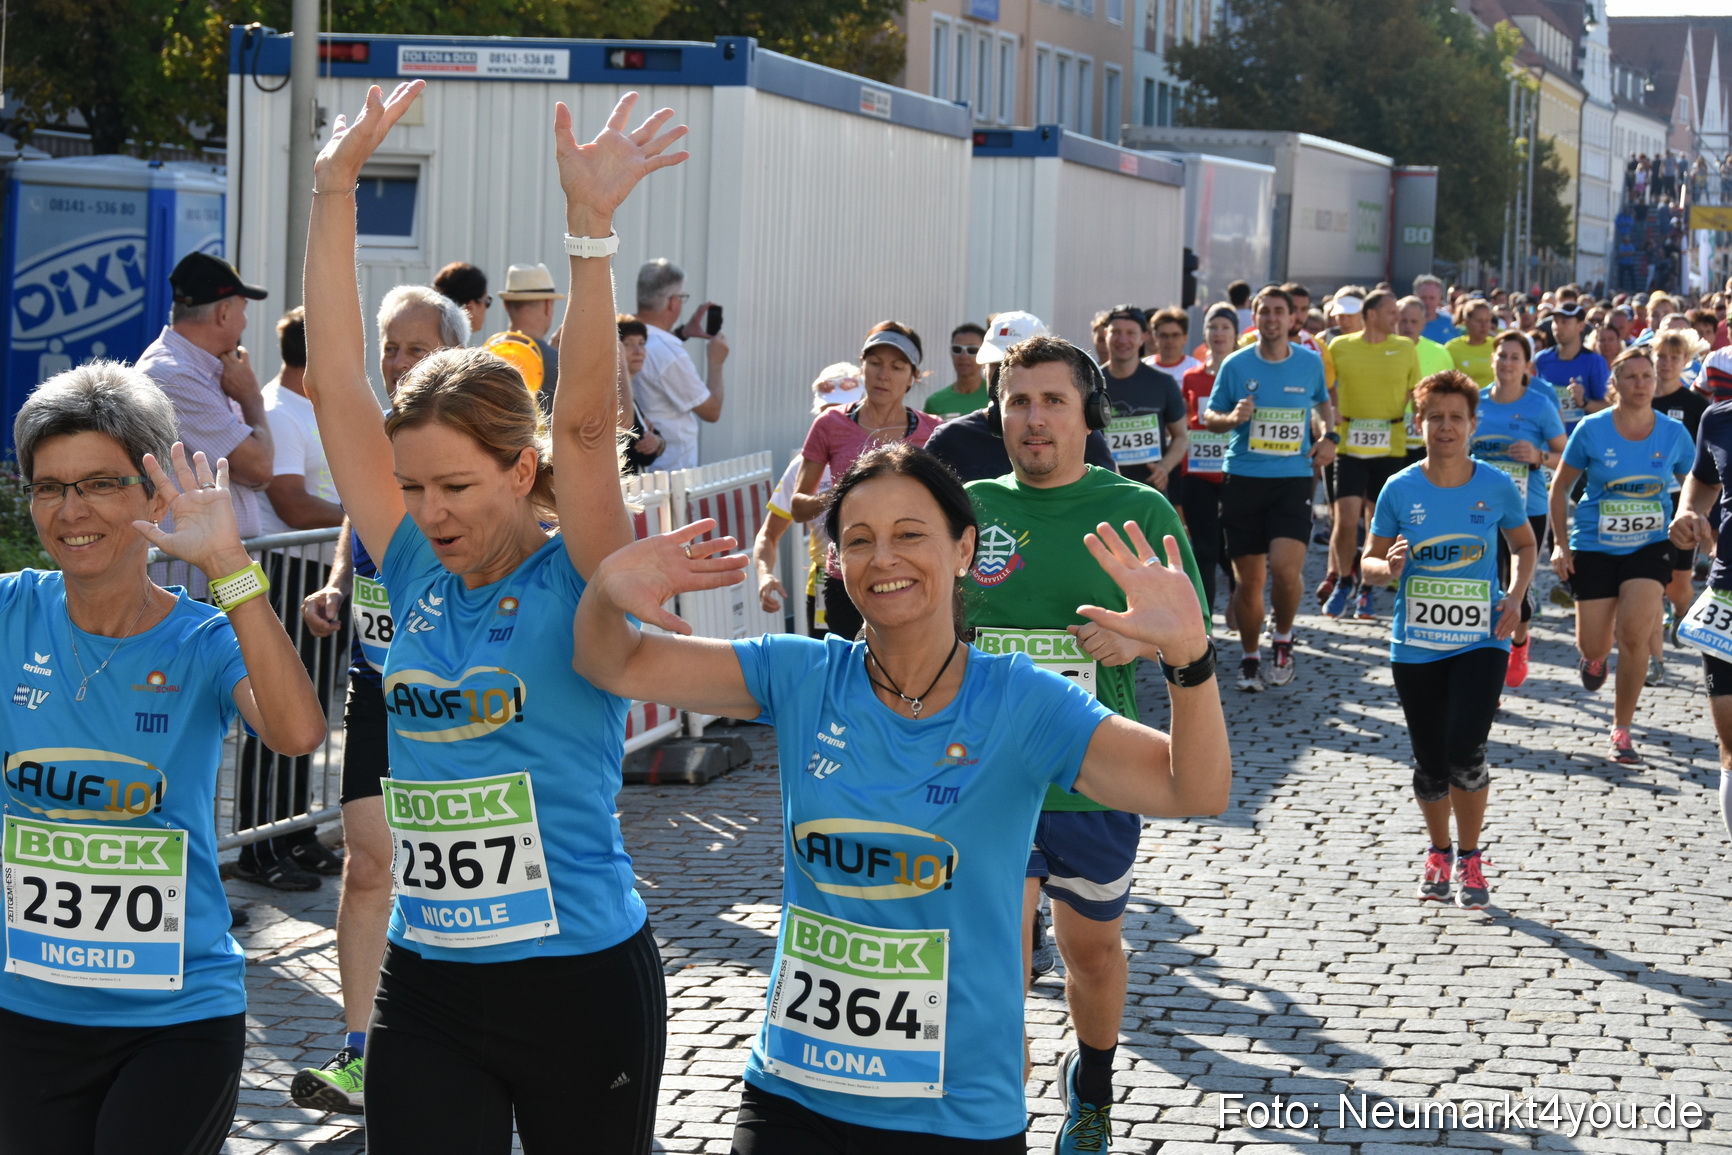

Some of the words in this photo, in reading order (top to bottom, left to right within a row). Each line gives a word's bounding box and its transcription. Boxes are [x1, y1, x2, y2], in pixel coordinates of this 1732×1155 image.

[120, 202, 136, 216] 80
[1111, 432, 1154, 449] 2438
[1258, 424, 1300, 440] 1189
[1353, 432, 1386, 446] 1397
[1263, 442, 1291, 450] PETER
[1602, 501, 1658, 514] BOCK
[1606, 516, 1656, 533] 2362
[1410, 545, 1486, 562] LAUF10!
[1412, 580, 1485, 599] BOCK
[417, 598, 443, 617] erima
[1415, 602, 1481, 627] 2009
[1413, 629, 1481, 643] STEPHANIE
[981, 634, 1086, 660] BOCK
[22, 662, 53, 677] erima
[135, 711, 169, 734] TUM
[817, 732, 847, 749] erima
[4, 750, 164, 815] LAUF10!
[390, 782, 519, 826] BOCK
[925, 784, 961, 805] TUM
[16, 824, 170, 870] BOCK
[523, 837, 532, 846] D
[401, 835, 517, 891] 2367
[791, 820, 954, 891] LAUF10!
[167, 889, 177, 898] D
[22, 876, 163, 933] 2370
[421, 902, 510, 928] NICOLE
[41, 941, 135, 969] INGRID
[792, 917, 930, 974] BOCK
[785, 970, 922, 1040] 2364
[928, 995, 938, 1005] C
[802, 1043, 887, 1077] ILONA
